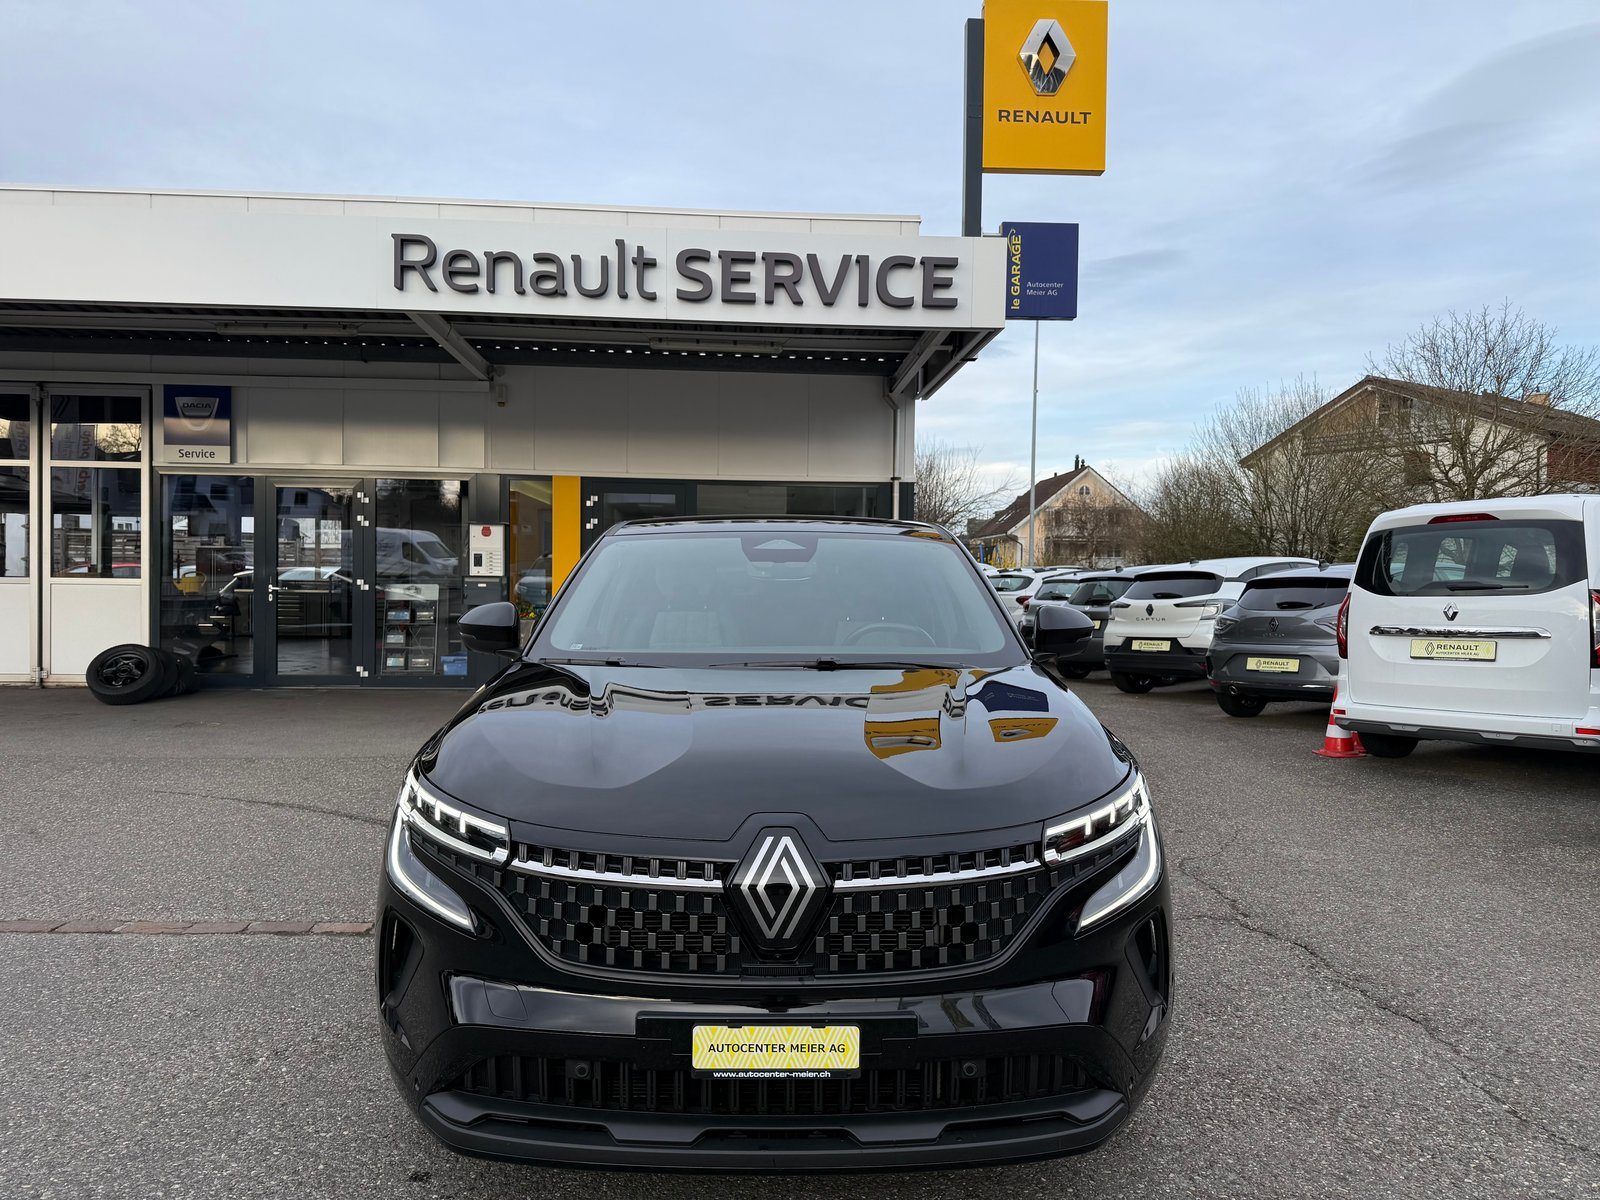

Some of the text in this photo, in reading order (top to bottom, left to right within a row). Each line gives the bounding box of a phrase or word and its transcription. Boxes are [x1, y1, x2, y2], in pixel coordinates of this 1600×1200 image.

[998, 109, 1092, 125] RENAULT
[391, 233, 959, 308] Renault SERVICE
[1010, 234, 1021, 310] le GARAGE
[178, 448, 215, 459] Service
[1436, 643, 1480, 651] RENAULT
[708, 1043, 846, 1053] AUTOCENTER MEIER AG
[713, 1070, 831, 1079] www.autocenter-meier.ch
